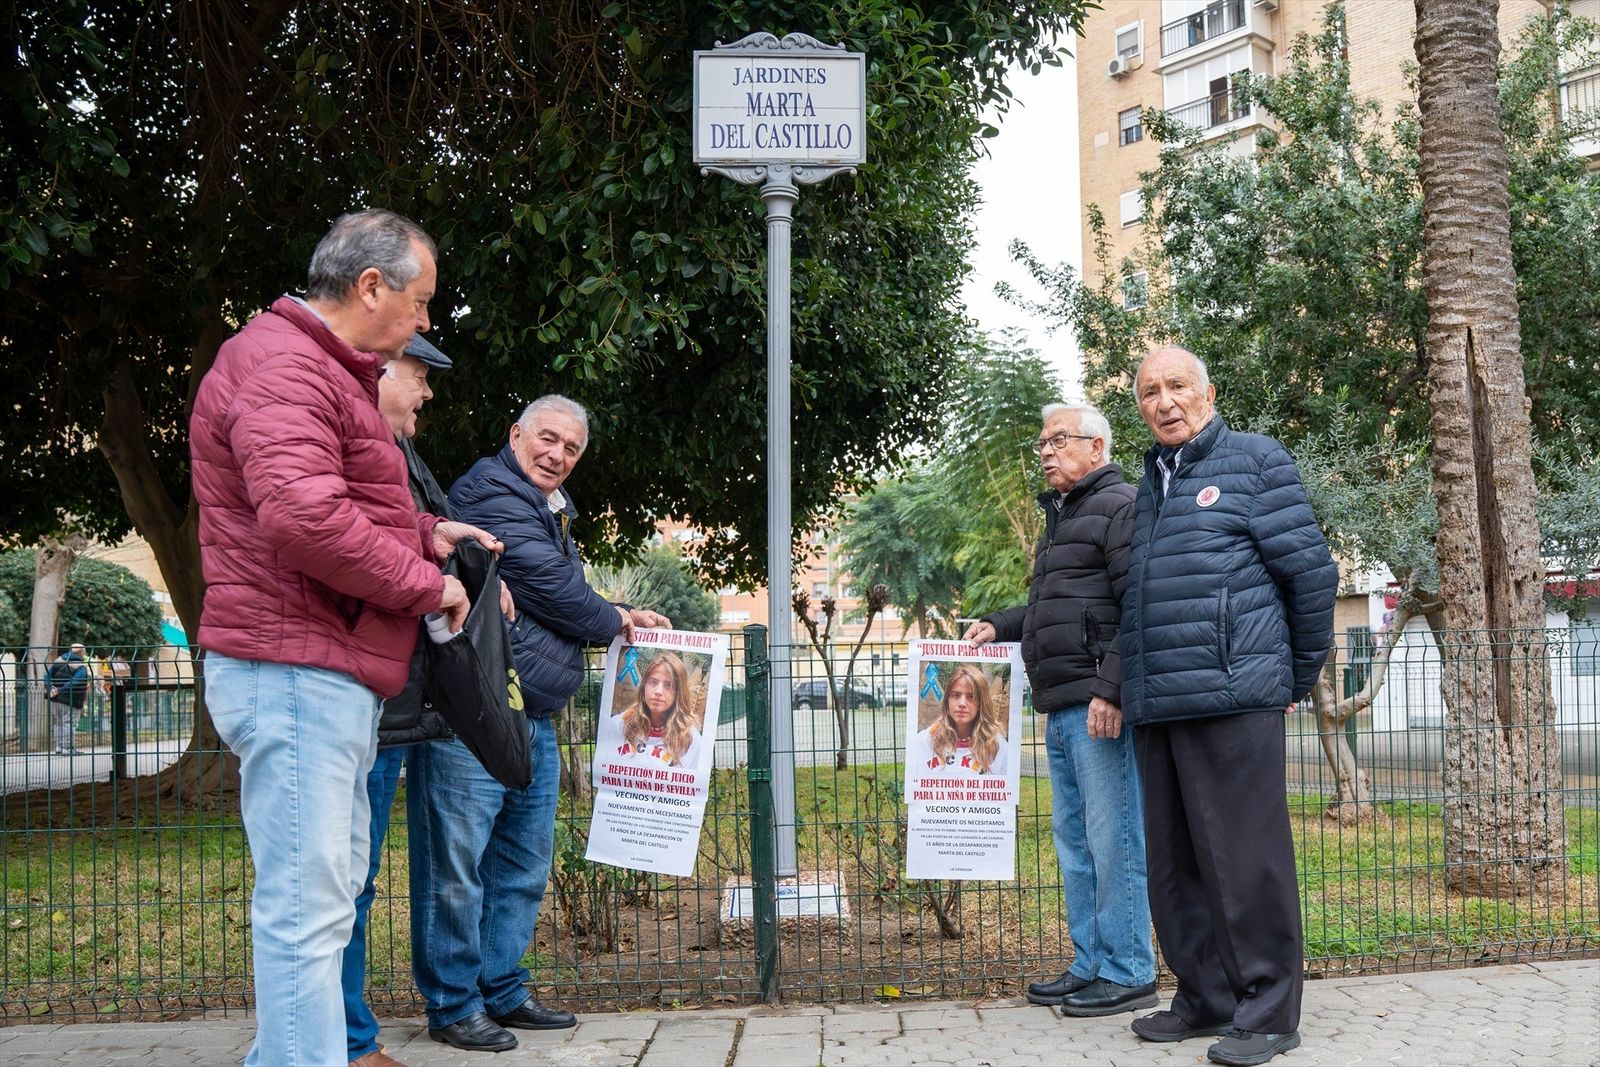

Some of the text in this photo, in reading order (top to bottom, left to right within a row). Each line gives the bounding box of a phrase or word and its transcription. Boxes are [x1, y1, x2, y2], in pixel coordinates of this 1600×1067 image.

[732, 67, 826, 86] JARDINES
[746, 92, 816, 117] MARTA
[711, 123, 852, 149] DEL CASTILLO
[660, 633, 682, 646] PARA
[958, 645, 979, 657] PARA
[608, 764, 653, 780] REPETICIÓN
[655, 770, 670, 781] DEL
[671, 773, 695, 784] JUICIO
[601, 776, 622, 787] PARA
[623, 778, 633, 788] LA
[635, 779, 653, 791] NIÑA
[654, 782, 665, 792] DE
[920, 777, 965, 789] REPETICIÓN
[966, 779, 980, 789] DEL
[982, 779, 1005, 790] JUICIO
[615, 790, 691, 808] VECINOS Y AMIGOS
[913, 791, 933, 801] PARA
[936, 792, 945, 801] LA
[947, 790, 964, 801] NIÑA
[966, 792, 976, 801] DE
[607, 802, 646, 814] NUEVAMENTE
[655, 809, 692, 820] NECESITAMOS
[925, 805, 1001, 815] VECINOS Y AMIGOS
[616, 827, 629, 835] AÑOS
[643, 831, 676, 841] DESAPARICION
[621, 837, 638, 845] MARTA
[648, 841, 669, 849] CASTILLO
